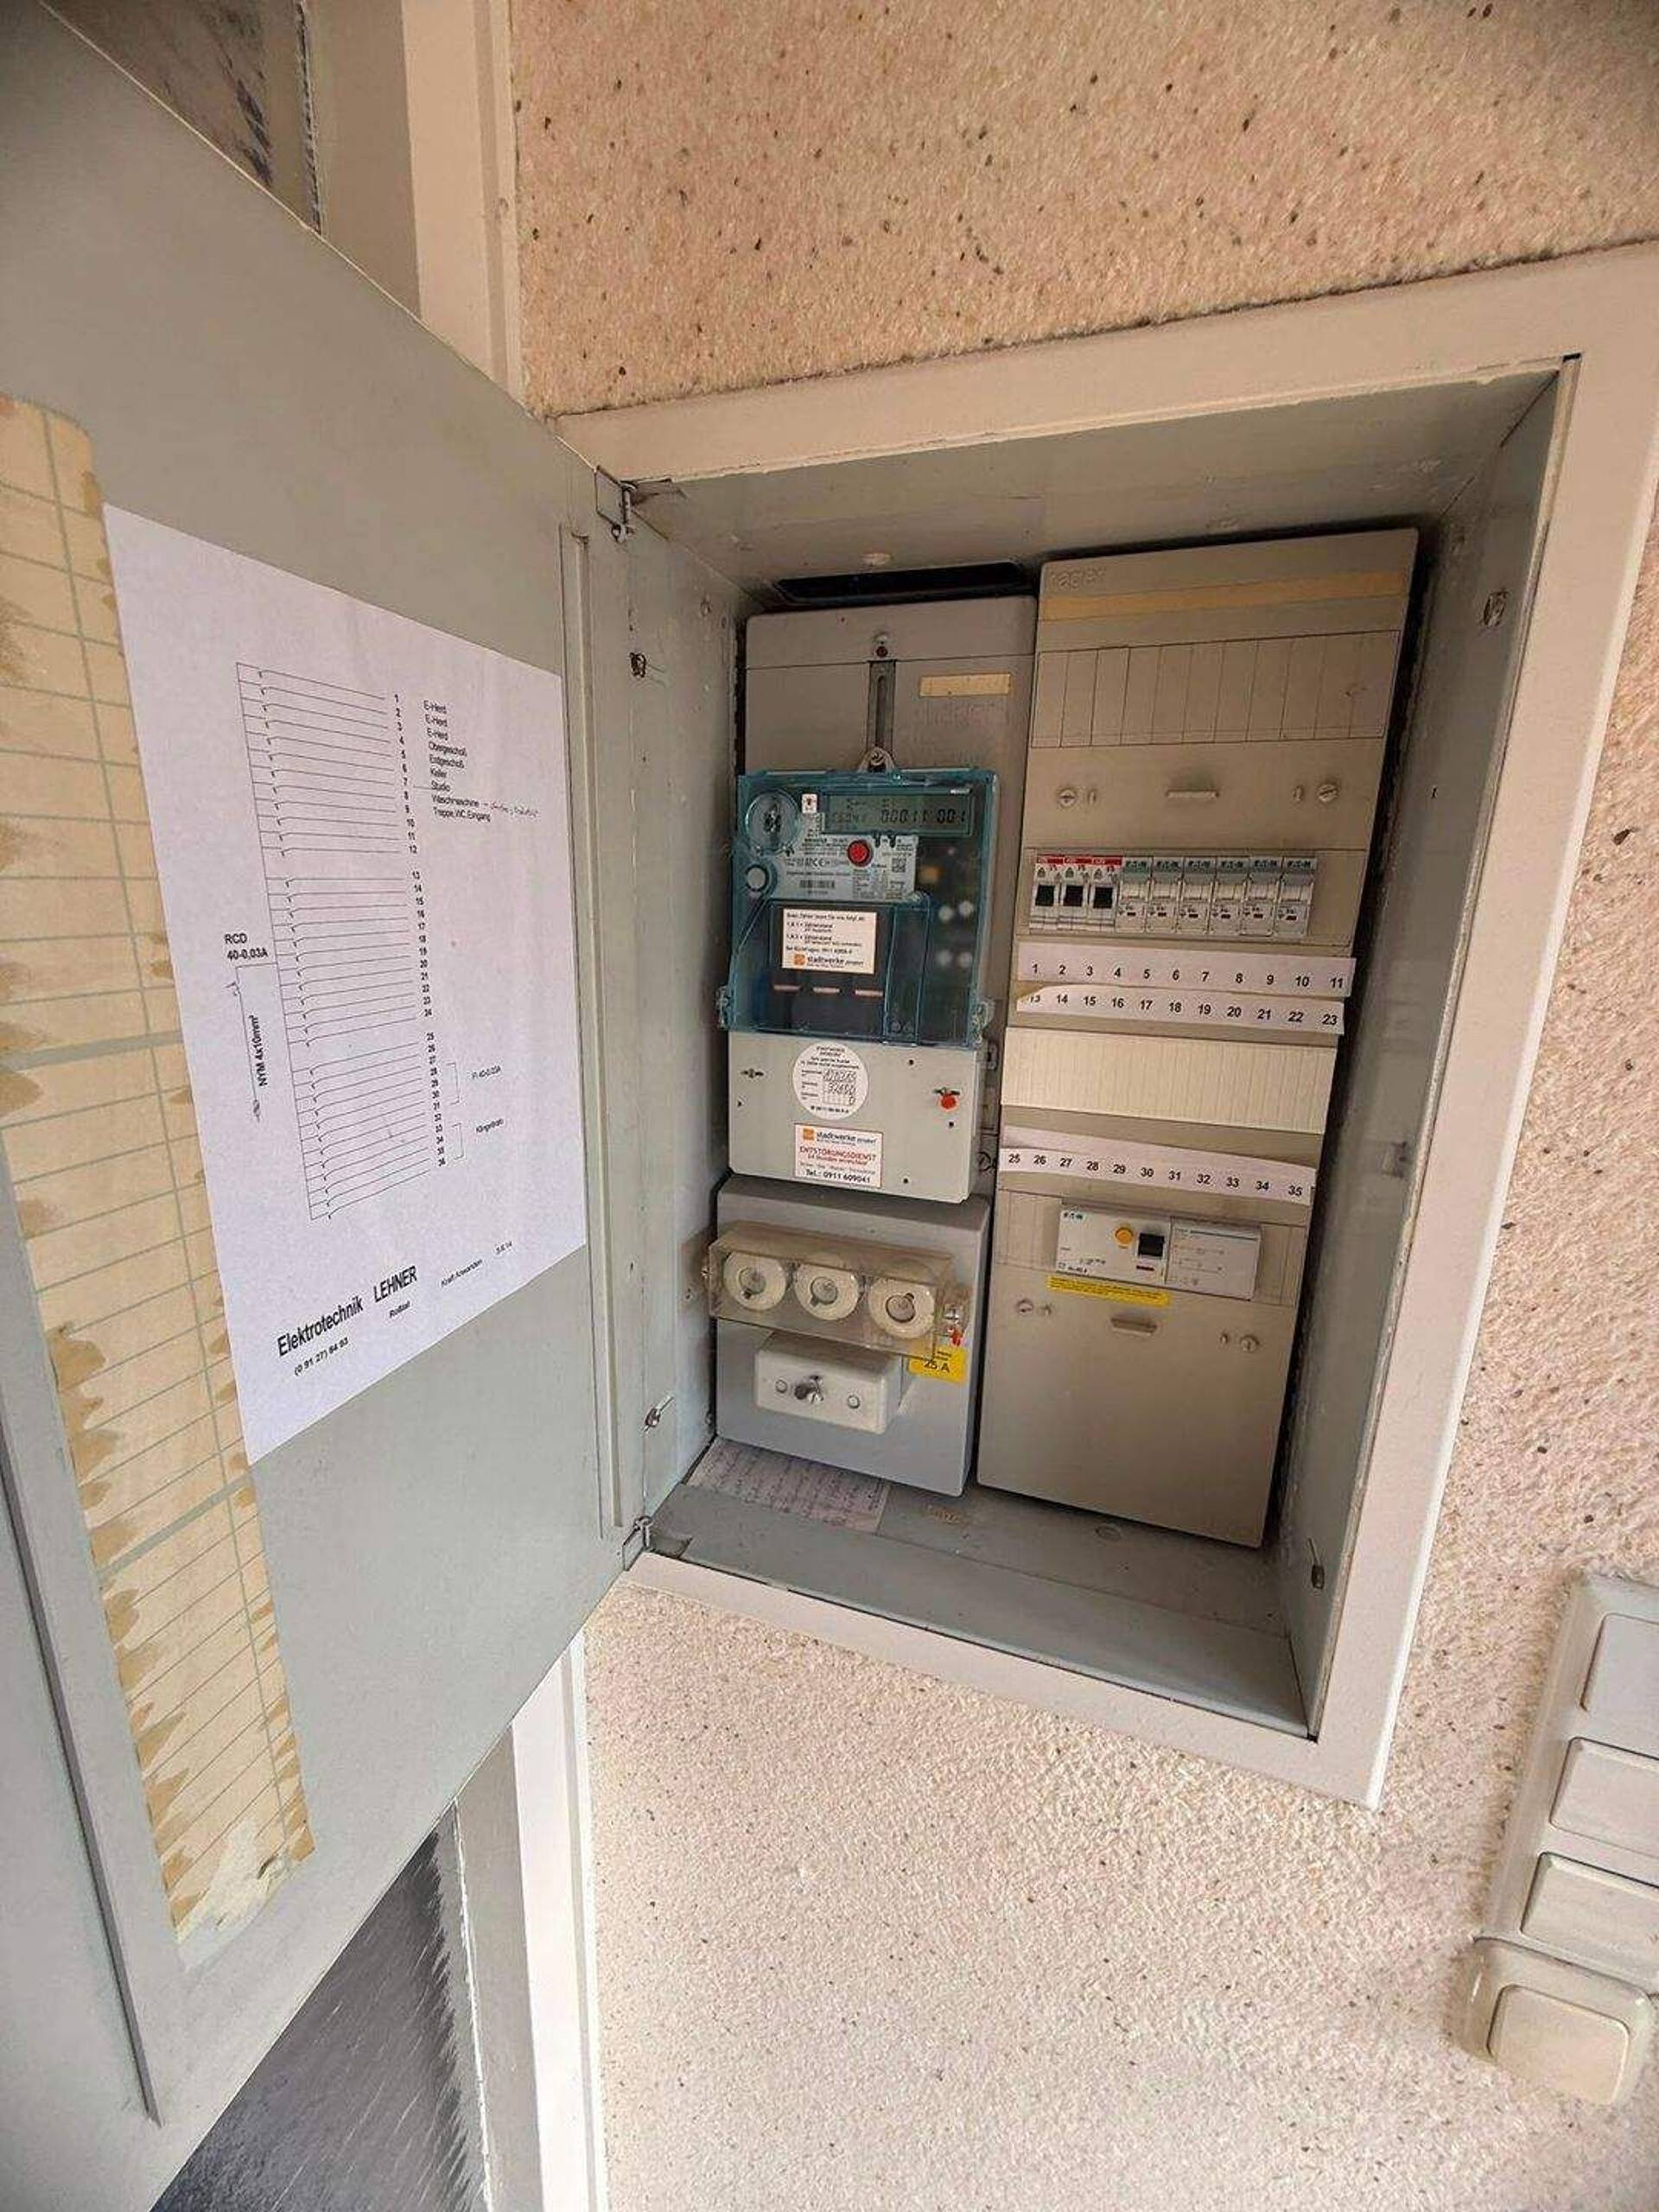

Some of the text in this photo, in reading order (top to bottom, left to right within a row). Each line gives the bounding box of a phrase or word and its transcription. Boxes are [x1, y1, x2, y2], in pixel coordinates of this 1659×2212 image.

[225, 933, 247, 944] RCD
[1032, 963, 1344, 988] 1 2 3 4 5 6 7 8 9 10 11
[1057, 994, 1069, 1004] 14
[1084, 995, 1096, 1007] 15
[1112, 997, 1124, 1008] 16
[1141, 999, 1154, 1010] 17
[1169, 1000, 1182, 1014] 18
[1198, 1003, 1211, 1015] 19
[1226, 1006, 1242, 1018] 20
[1257, 1008, 1271, 1020] 21
[1287, 1011, 1304, 1023] 22
[1321, 1013, 1338, 1026] 23
[256, 1061, 268, 1086] NYM
[817, 1131, 856, 1141] stadtwerke
[800, 1146, 876, 1161] ENTSTÖRUNGSDIENST
[842, 1174, 870, 1183] 609041
[1008, 1154, 1303, 1198] 25 26 27 28 29 30 31 32 33 34 35
[277, 1265, 417, 1357] Elektrotechnik LEHNER
[304, 1357, 314, 1369] 91
[941, 1363, 950, 1374] A
